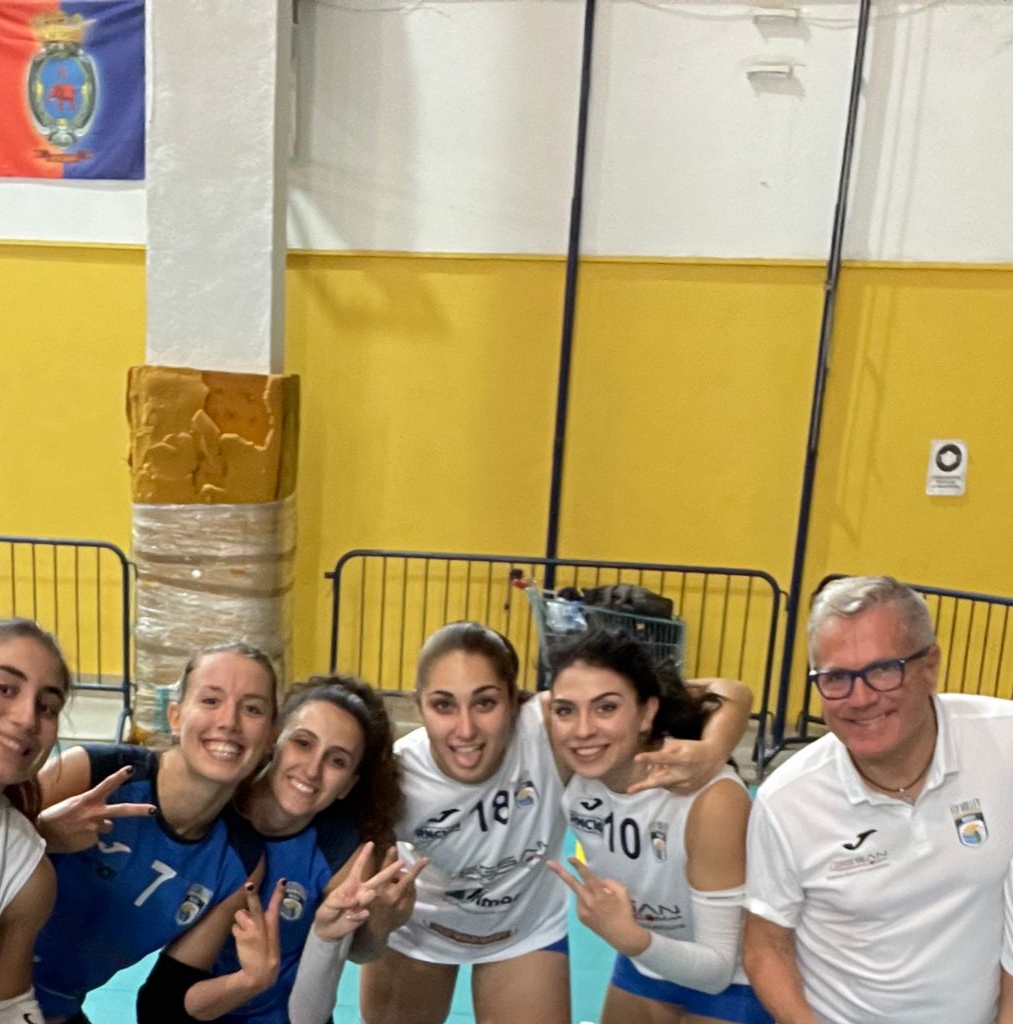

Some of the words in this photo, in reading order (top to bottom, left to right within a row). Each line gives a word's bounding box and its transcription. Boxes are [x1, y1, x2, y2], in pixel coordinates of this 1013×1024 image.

[469, 789, 510, 833] 18
[604, 811, 642, 860] 10
[134, 859, 178, 907] 7
